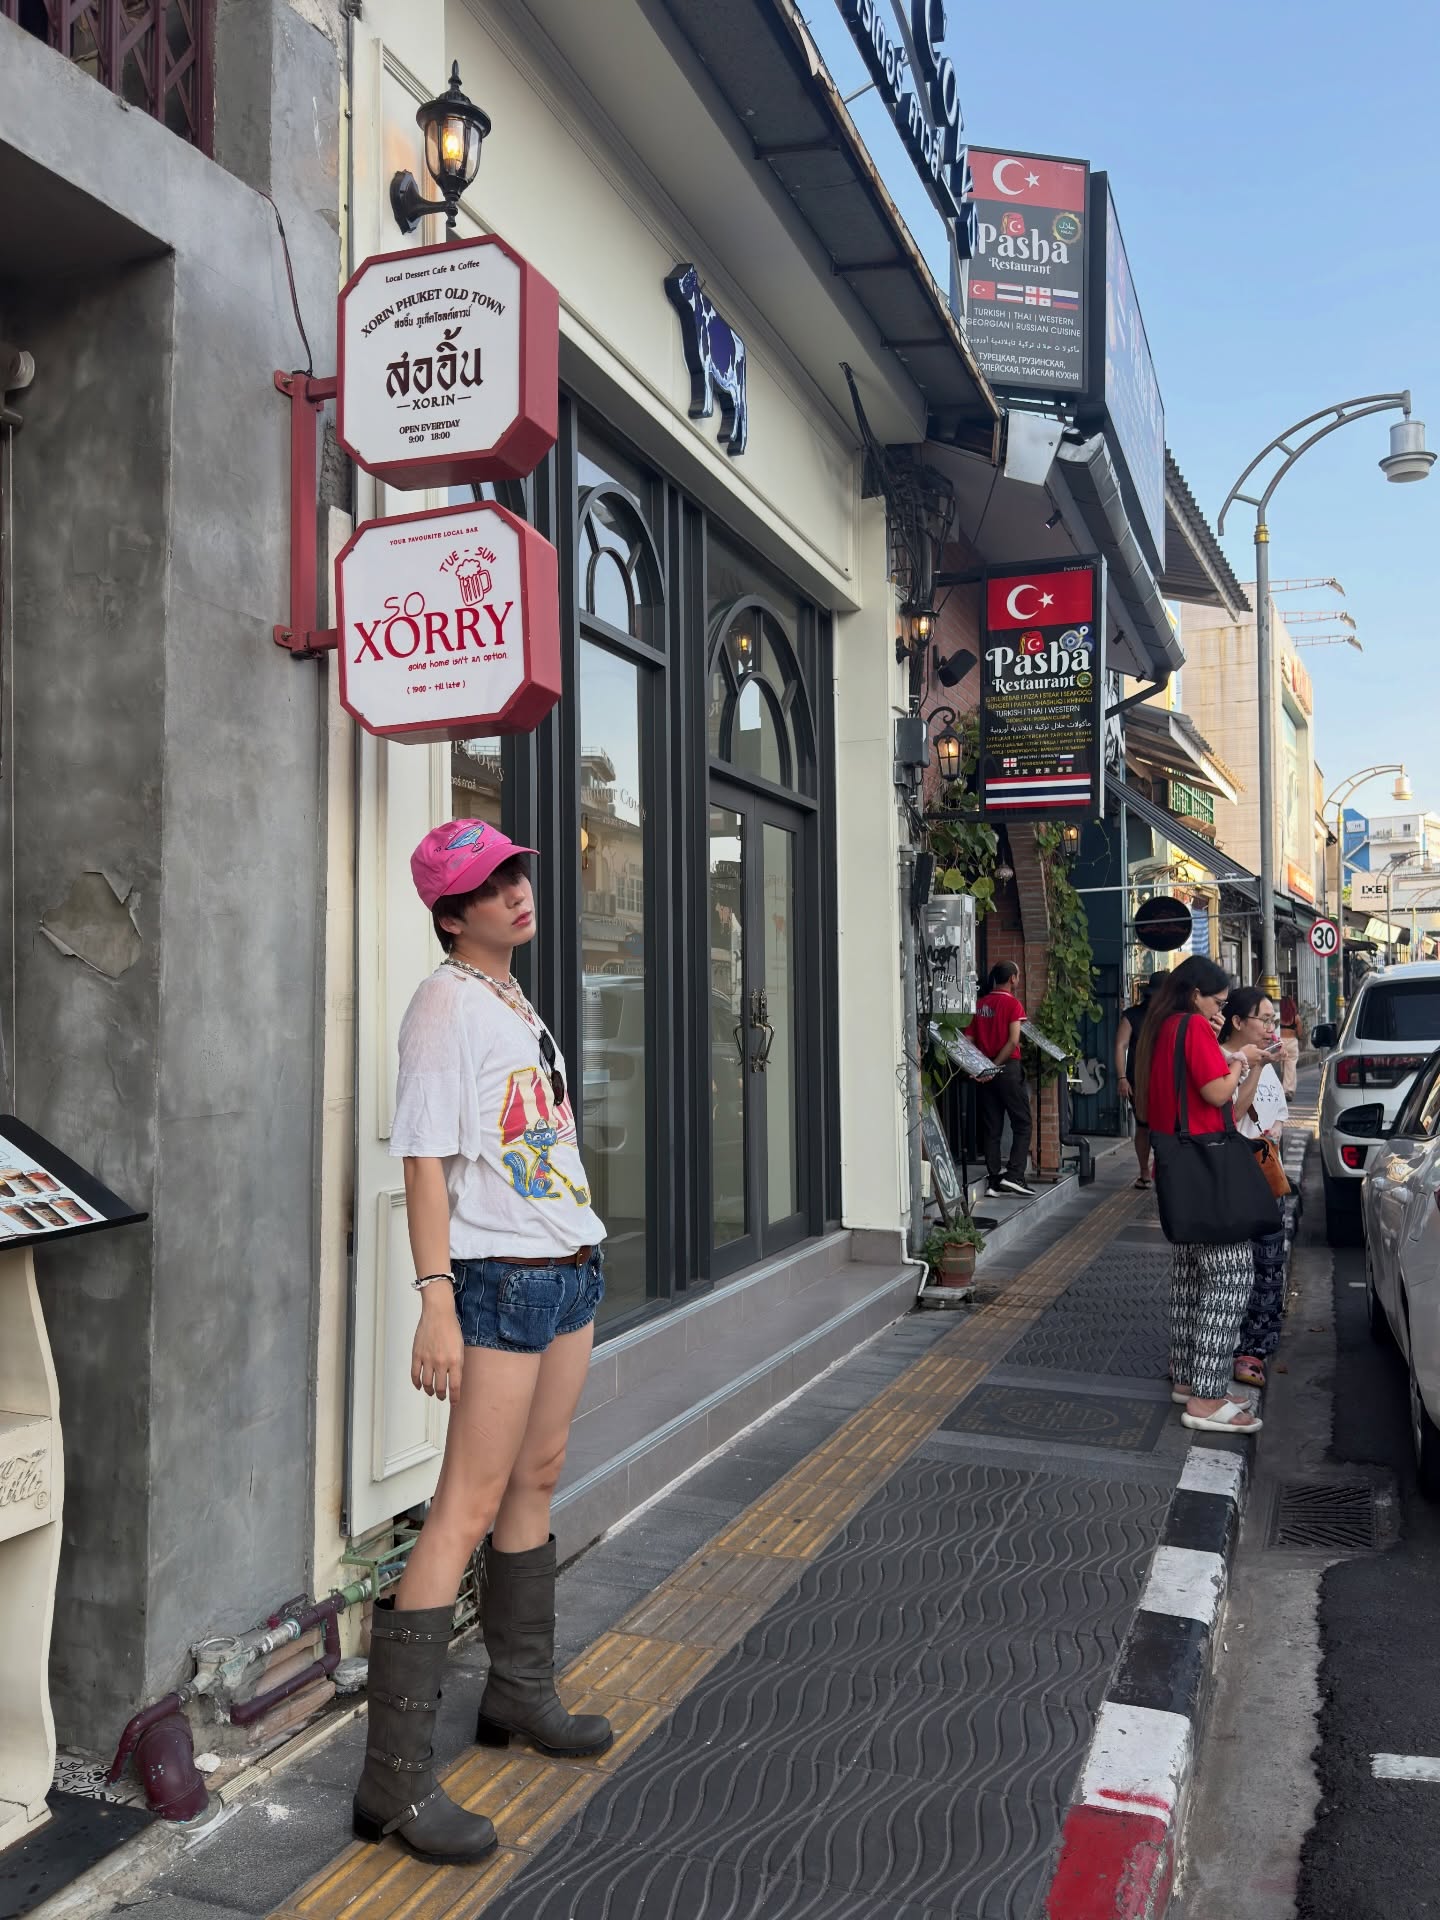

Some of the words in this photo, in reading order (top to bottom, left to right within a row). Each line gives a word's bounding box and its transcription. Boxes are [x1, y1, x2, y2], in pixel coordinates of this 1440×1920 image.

[978, 223, 1069, 264] Pasha
[386, 273, 402, 283] Local
[406, 270, 430, 280] Dessert
[432, 266, 447, 274] Cafe
[458, 260, 480, 270] Coffee
[989, 257, 1051, 274] Restaurant
[361, 306, 394, 338] XORIN
[396, 288, 442, 312] PHUKET
[445, 288, 468, 300] OLD
[472, 292, 506, 316] TOWN
[974, 308, 1006, 318] TURKISH
[1014, 312, 1031, 320] THAI
[1038, 315, 1074, 326] WESTERN
[966, 318, 1010, 328] GEORGIAN
[1016, 323, 1048, 333] RUSSIAN
[1050, 327, 1080, 337] CUISINE
[978, 352, 1018, 364] ТУРЕЦКАЯ,
[1018, 356, 1066, 369] ГРУЗИНСКАЯ,
[1022, 367, 1054, 378] ТАЙСКАЯ
[1056, 372, 1079, 380] КУХНЯ
[412, 394, 456, 410] XORIN
[400, 424, 420, 434] OPEN
[421, 419, 460, 432] EVERYDAY
[409, 434, 424, 443] 9:00
[431, 432, 450, 440] 18:00
[408, 533, 442, 542] FAVOURITE
[444, 530, 463, 538] LOCAL
[440, 550, 459, 573] TUE
[475, 546, 497, 564] SUN
[382, 592, 426, 624] SO
[354, 601, 514, 663] XORRY
[408, 662, 426, 672] going
[430, 660, 449, 668] home
[452, 656, 468, 665] isn't
[484, 652, 507, 663] option
[986, 641, 1091, 678] Pasha
[992, 674, 1076, 694] Restaurant
[1313, 926, 1336, 950] 30
